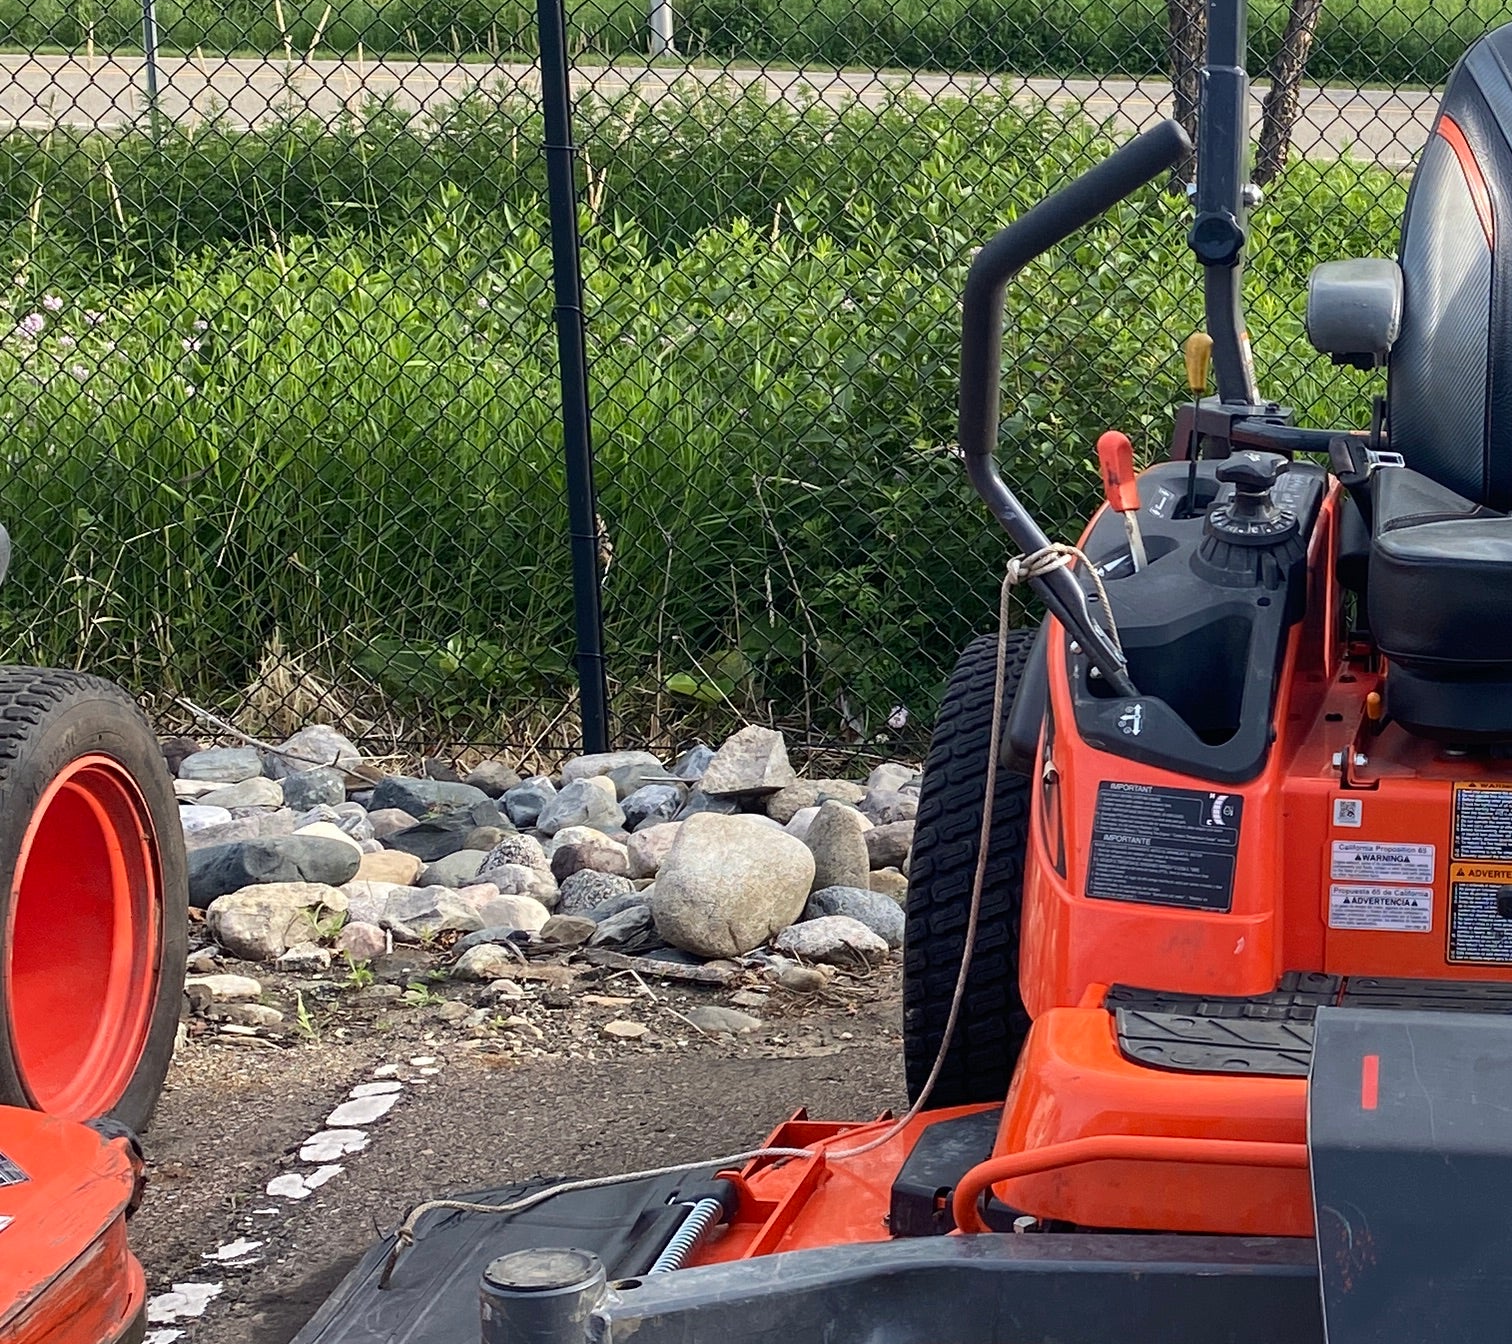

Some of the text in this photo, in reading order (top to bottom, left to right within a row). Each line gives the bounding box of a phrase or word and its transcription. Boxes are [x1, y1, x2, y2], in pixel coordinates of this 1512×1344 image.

[1110, 783, 1153, 793] IMPORTANT
[1103, 834, 1151, 846] IMPORTANTE
[1339, 844, 1373, 852] California
[1376, 845, 1416, 854] Proposition
[1362, 855, 1404, 863] WARNING
[1333, 887, 1370, 895] Propuesta
[1352, 897, 1410, 907] ADVERTENCIA
